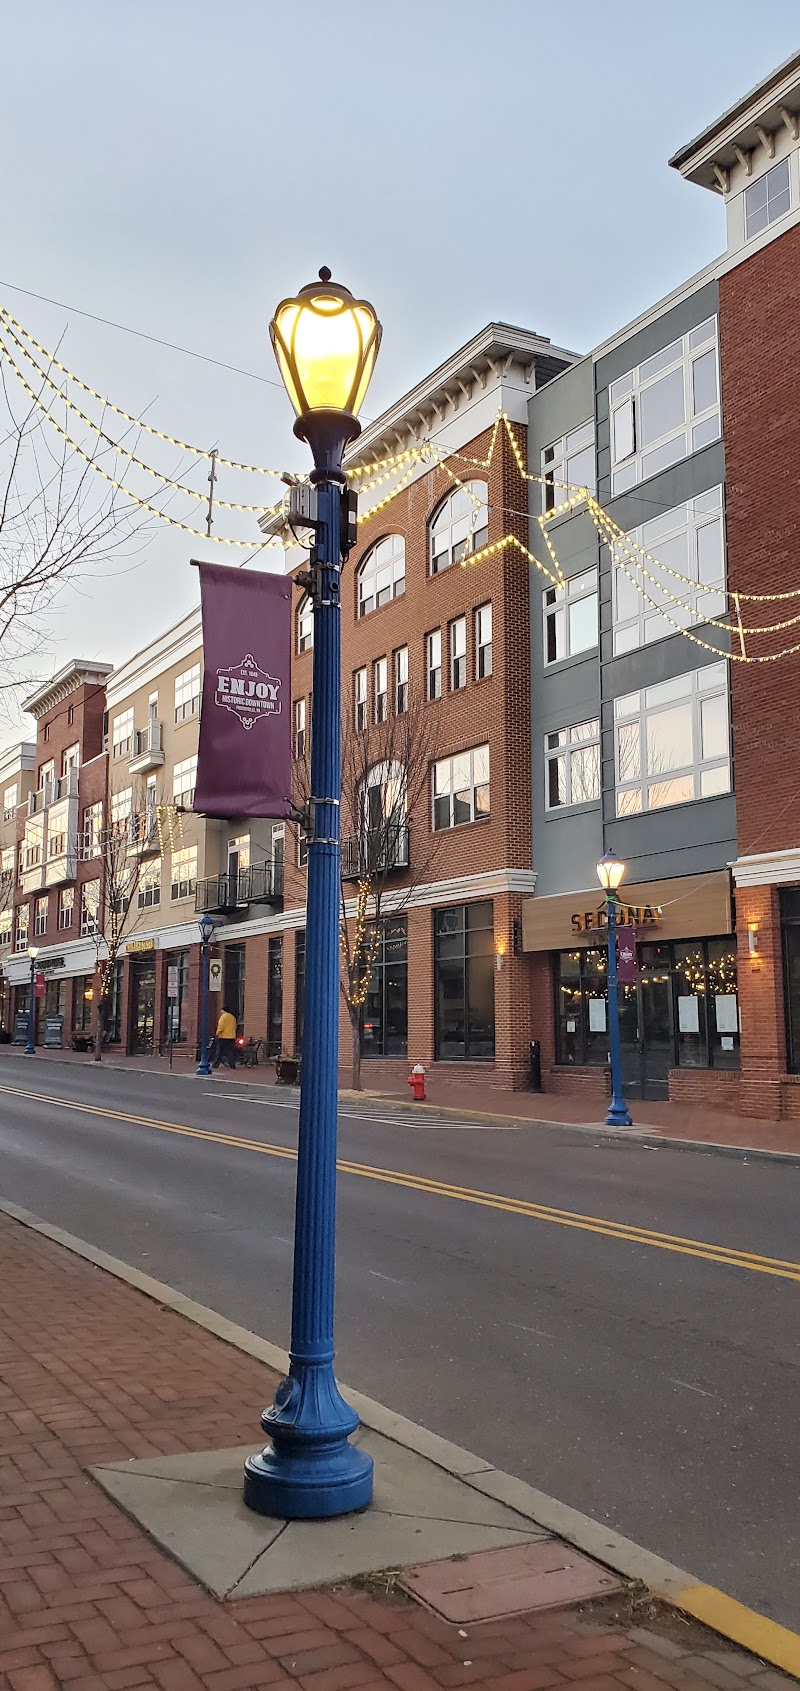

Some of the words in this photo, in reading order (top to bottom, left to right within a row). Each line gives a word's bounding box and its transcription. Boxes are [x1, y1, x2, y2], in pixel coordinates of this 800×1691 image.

[217, 676, 279, 700] ENJOY
[222, 695, 245, 705] HISTORIC
[245, 698, 274, 709] DOWNTOWN
[571, 906, 656, 931] SEDONA
